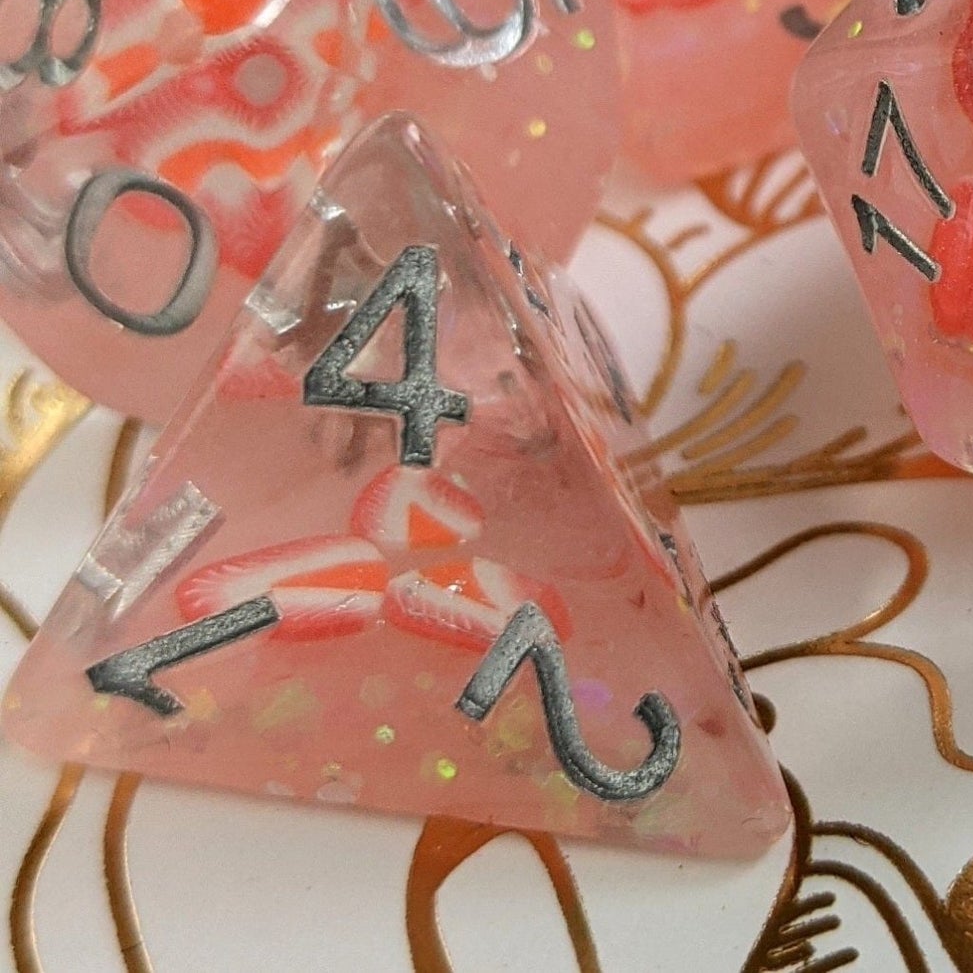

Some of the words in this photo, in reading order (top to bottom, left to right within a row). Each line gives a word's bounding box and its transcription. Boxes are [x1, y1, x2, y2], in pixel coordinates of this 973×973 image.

[65, 168, 220, 336] 0
[851, 79, 955, 282] 17
[303, 243, 468, 468] 4
[85, 594, 281, 717] 1
[455, 601, 681, 800] 2
